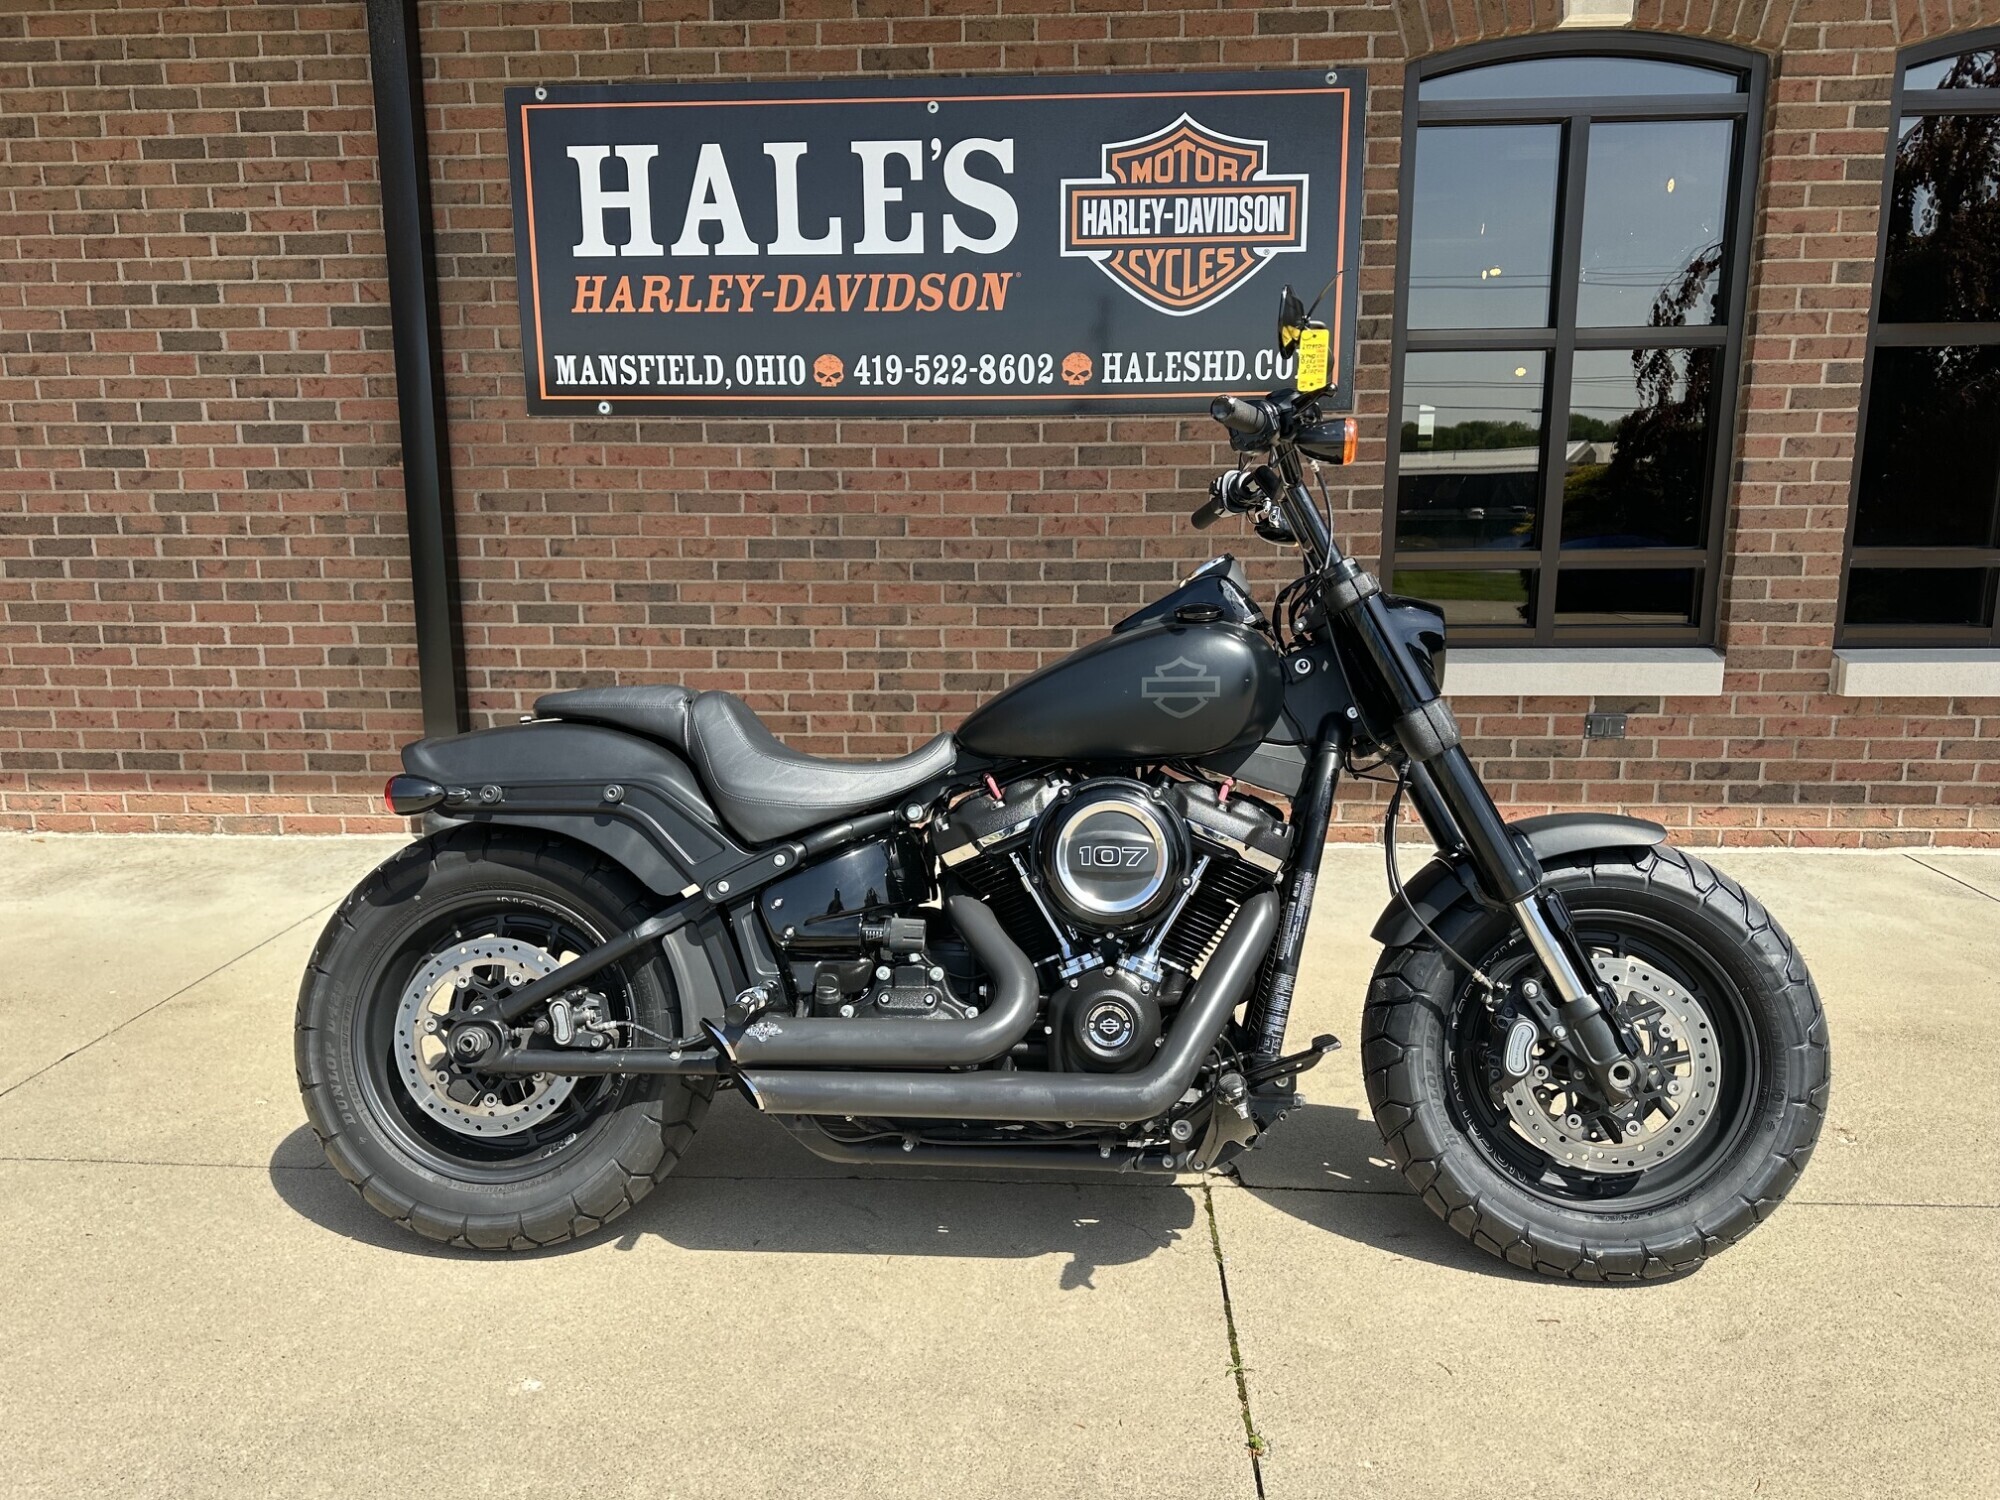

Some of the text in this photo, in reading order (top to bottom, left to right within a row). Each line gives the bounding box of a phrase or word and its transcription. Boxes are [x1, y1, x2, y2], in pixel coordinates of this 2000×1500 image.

[1131, 139, 1239, 184] MOTOR
[567, 137, 1018, 257] HALE'S
[1082, 195, 1286, 236] HARLEY-DAVIDSON
[571, 273, 1015, 313] HARLEY-DAVIDSON
[1128, 247, 1236, 297] CYCLES
[853, 353, 1054, 387] 419-522-8602
[1101, 348, 1301, 384] HALESHD.CO
[1079, 845, 1148, 866] 107
[326, 1043, 357, 1125] DUNLOP
[1426, 1060, 1458, 1147] DUNLOP
